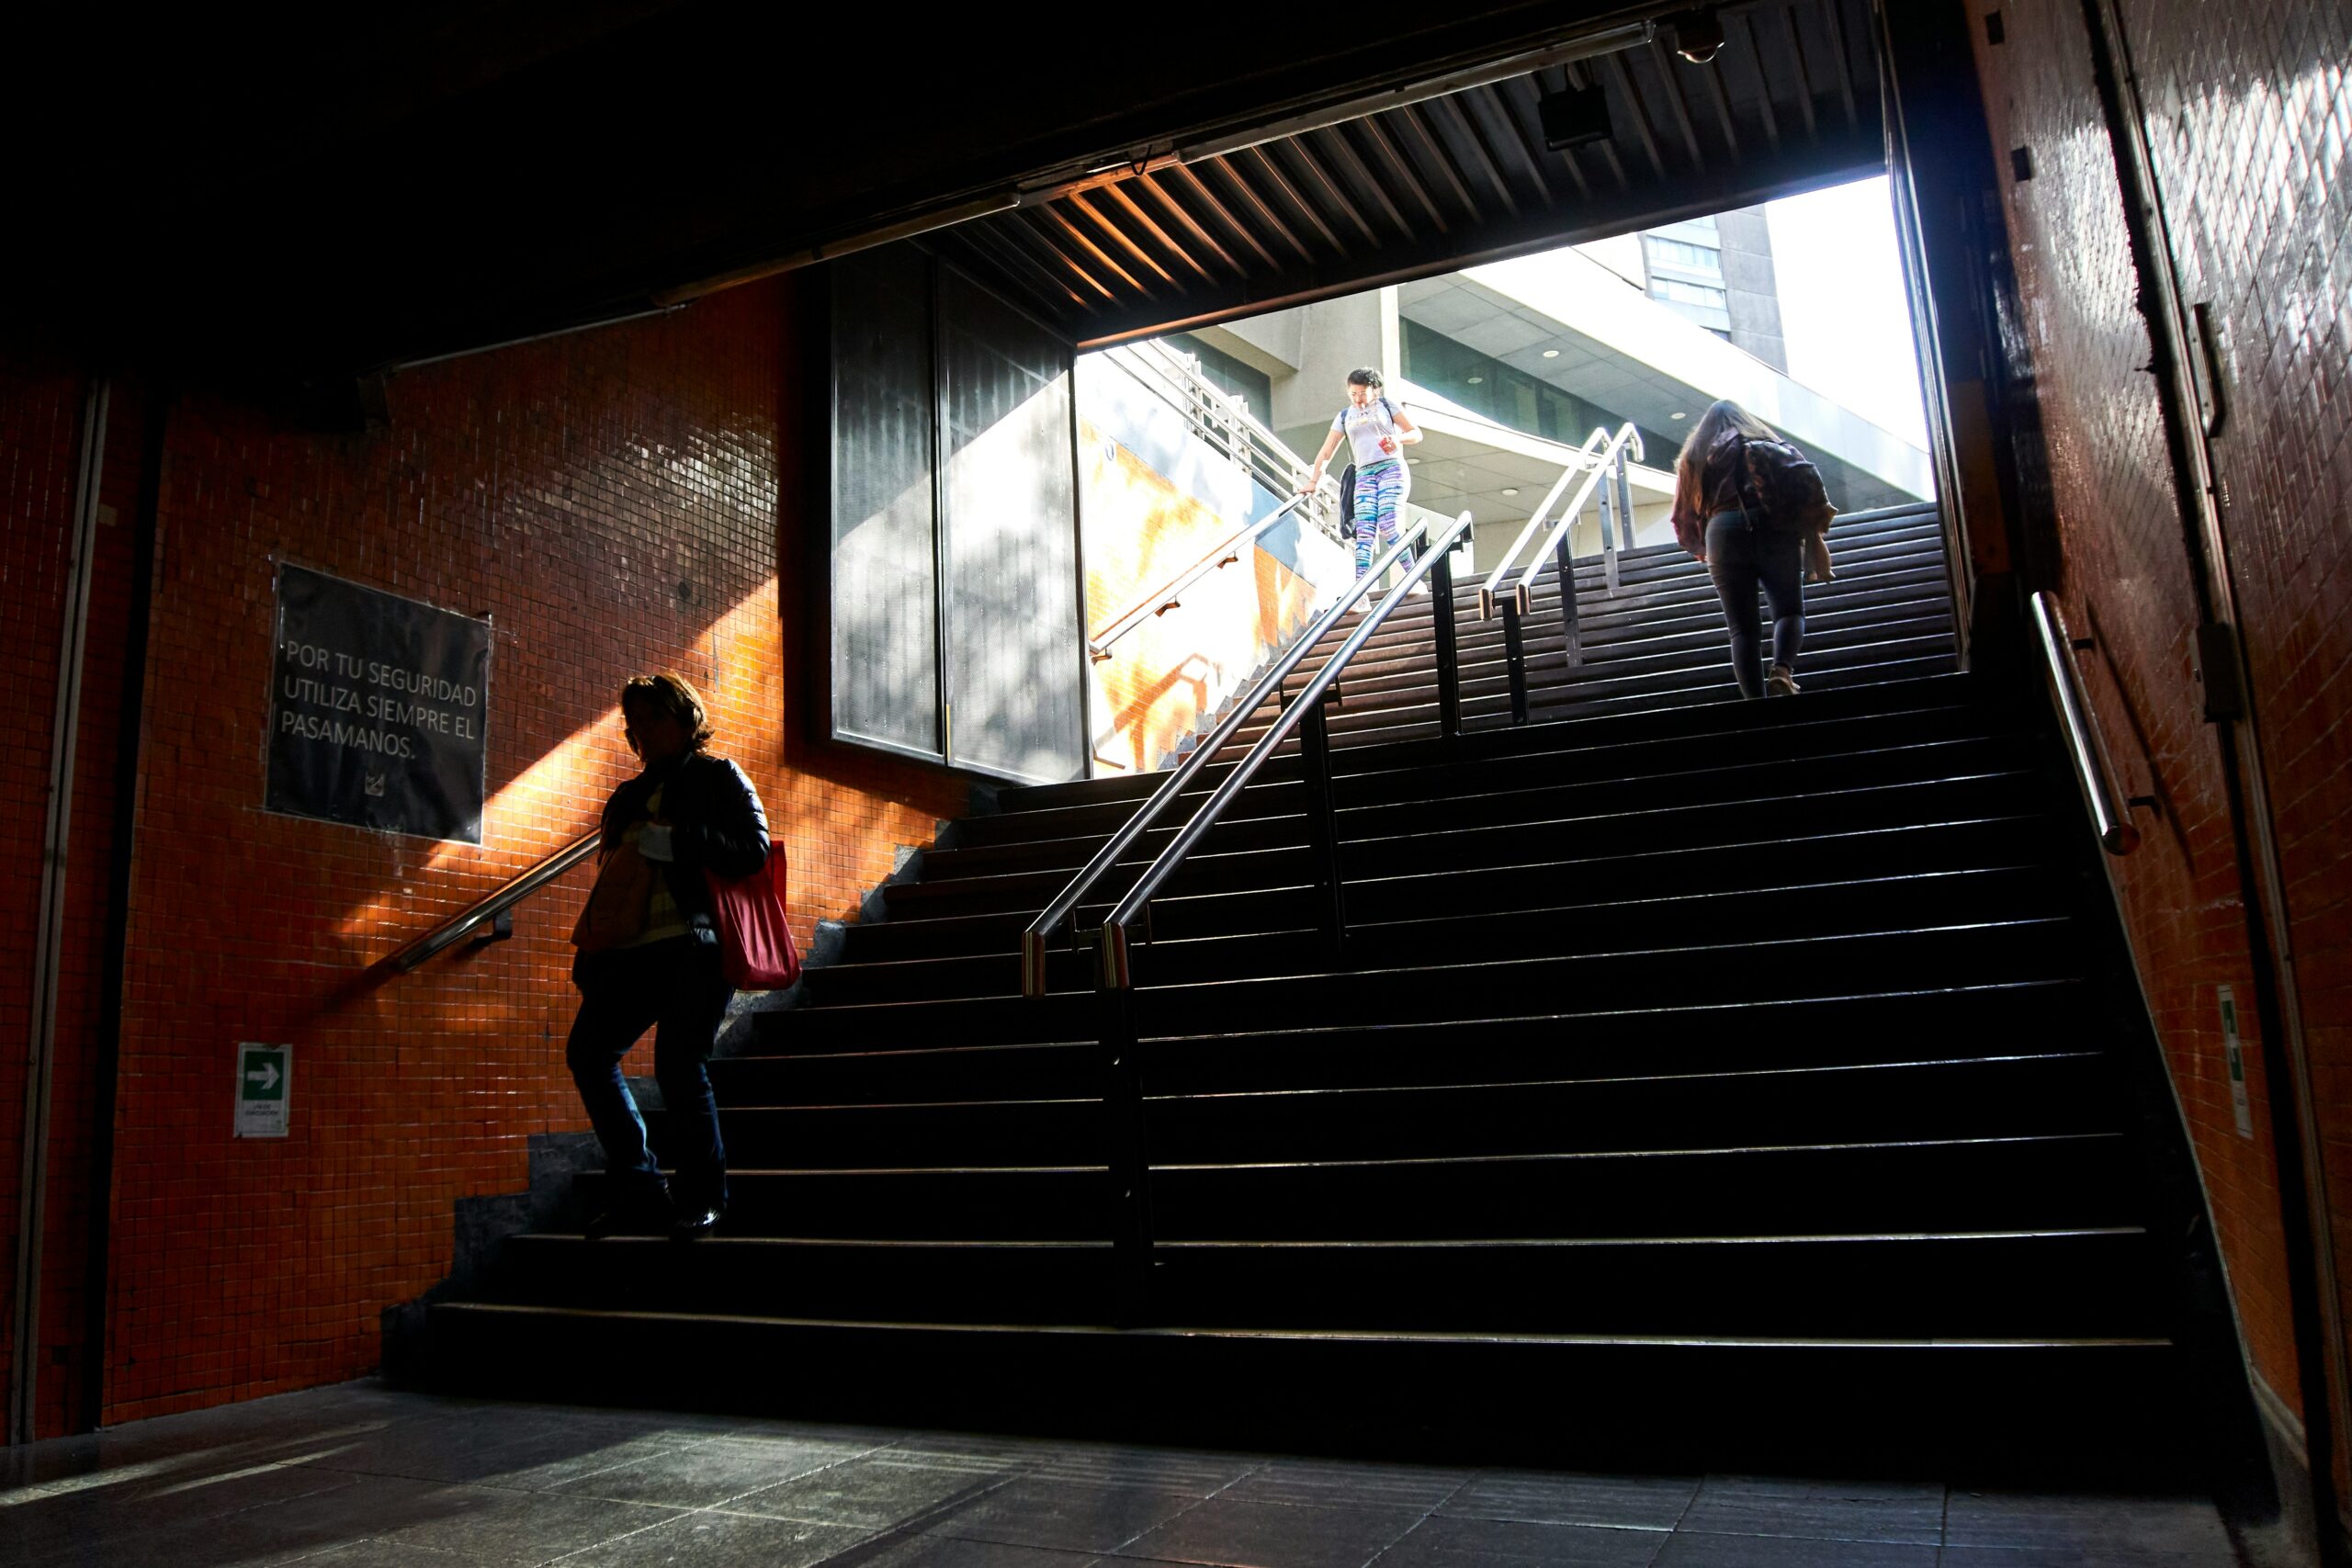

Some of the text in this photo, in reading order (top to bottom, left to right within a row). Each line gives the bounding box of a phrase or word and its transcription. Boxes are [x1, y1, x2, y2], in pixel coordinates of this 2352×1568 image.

[287, 640, 477, 707] POR TU SEGURIDAD
[281, 711, 416, 760] PASAMANOS.
[284, 675, 475, 739] UTILIZA SIEMPRE EL
